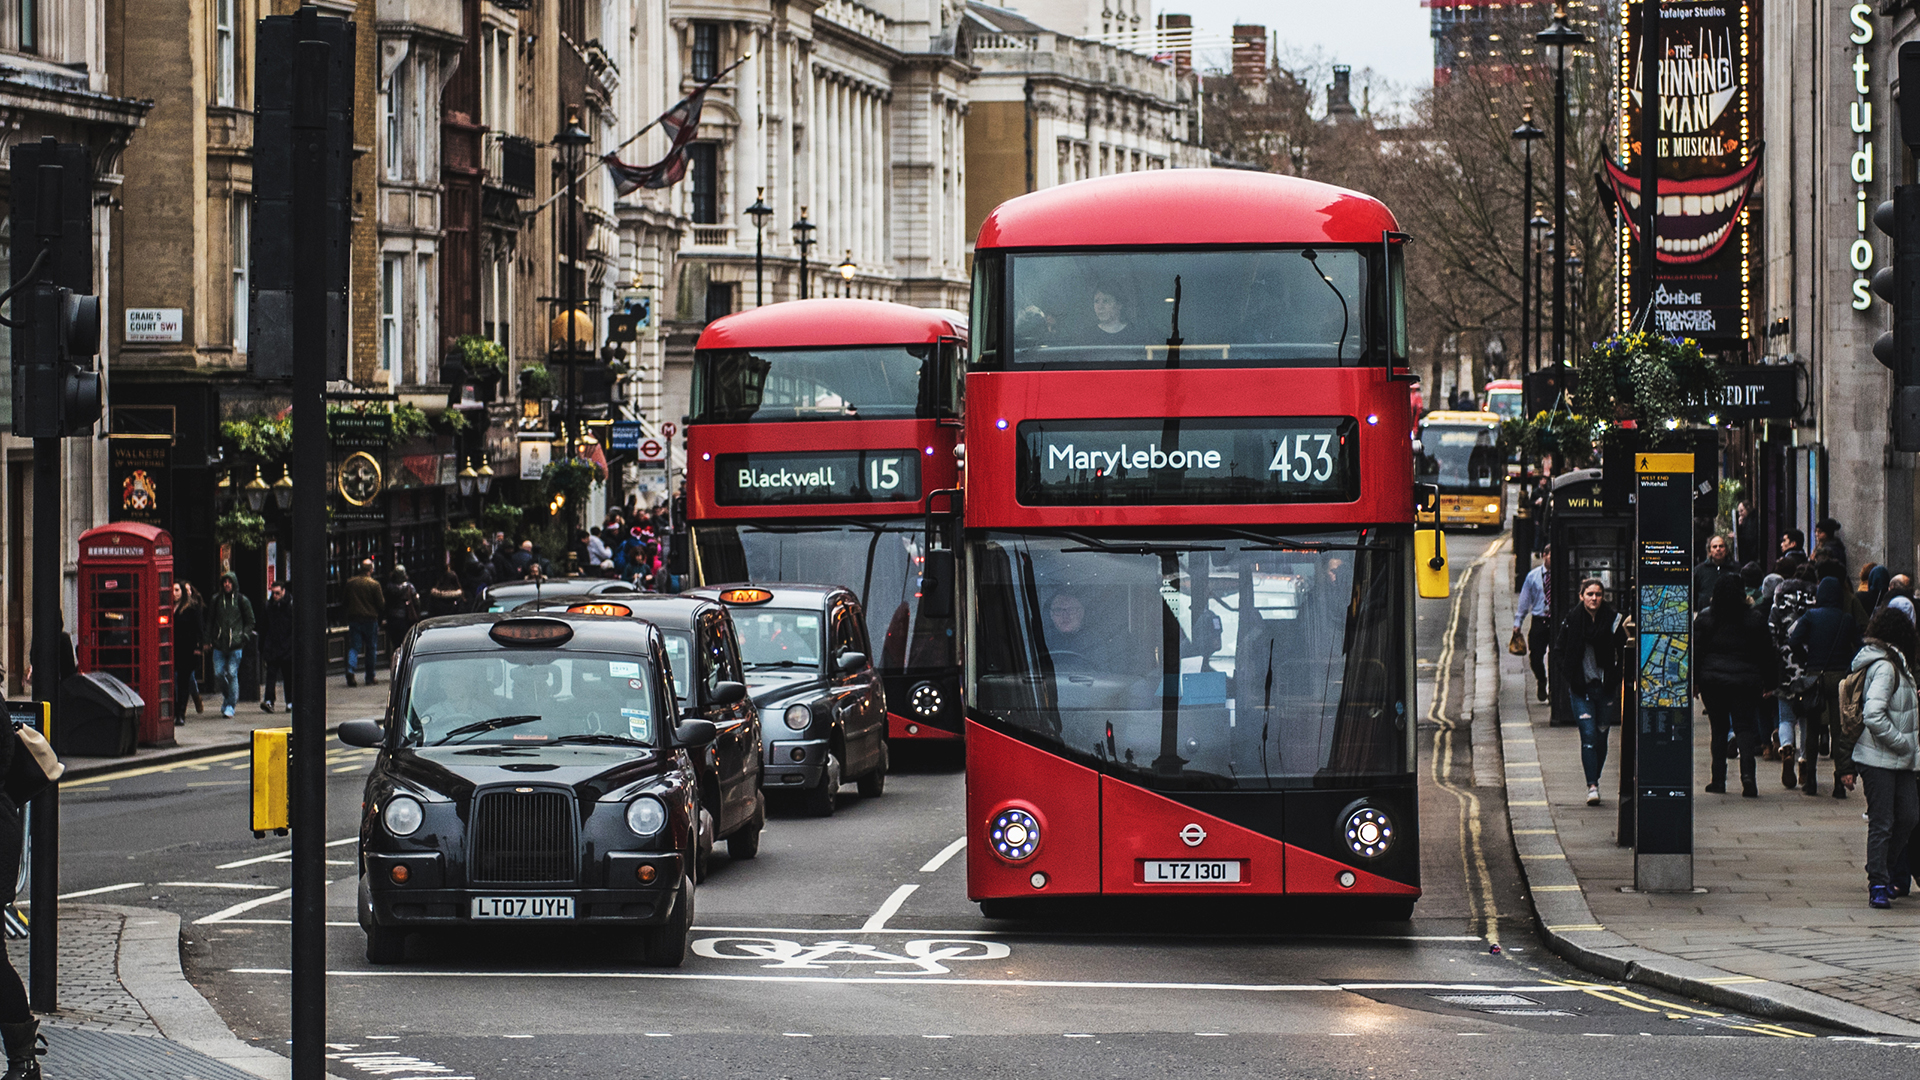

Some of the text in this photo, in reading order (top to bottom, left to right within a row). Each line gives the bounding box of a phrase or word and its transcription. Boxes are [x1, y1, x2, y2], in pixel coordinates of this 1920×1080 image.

[1659, 6, 1726, 20] rafalgar Studios
[1674, 45, 1693, 58] THE
[1639, 57, 1730, 96] RINNING
[1660, 94, 1708, 133] MAN
[1673, 136, 1724, 157] MUSICAL
[1850, 3, 1873, 311] Studios
[130, 311, 162, 321] CRAIG'S
[130, 322, 177, 331] COURT SW1
[1666, 320, 1716, 331] BETWEEN
[115, 448, 165, 459] WALKERS
[1048, 434, 1333, 482] Marylebone 453
[738, 458, 900, 490] Blackwall 15
[730, 592, 759, 601] TAXI
[1158, 864, 1226, 879] LTZ 1301
[479, 899, 568, 916] LT07 UYH
